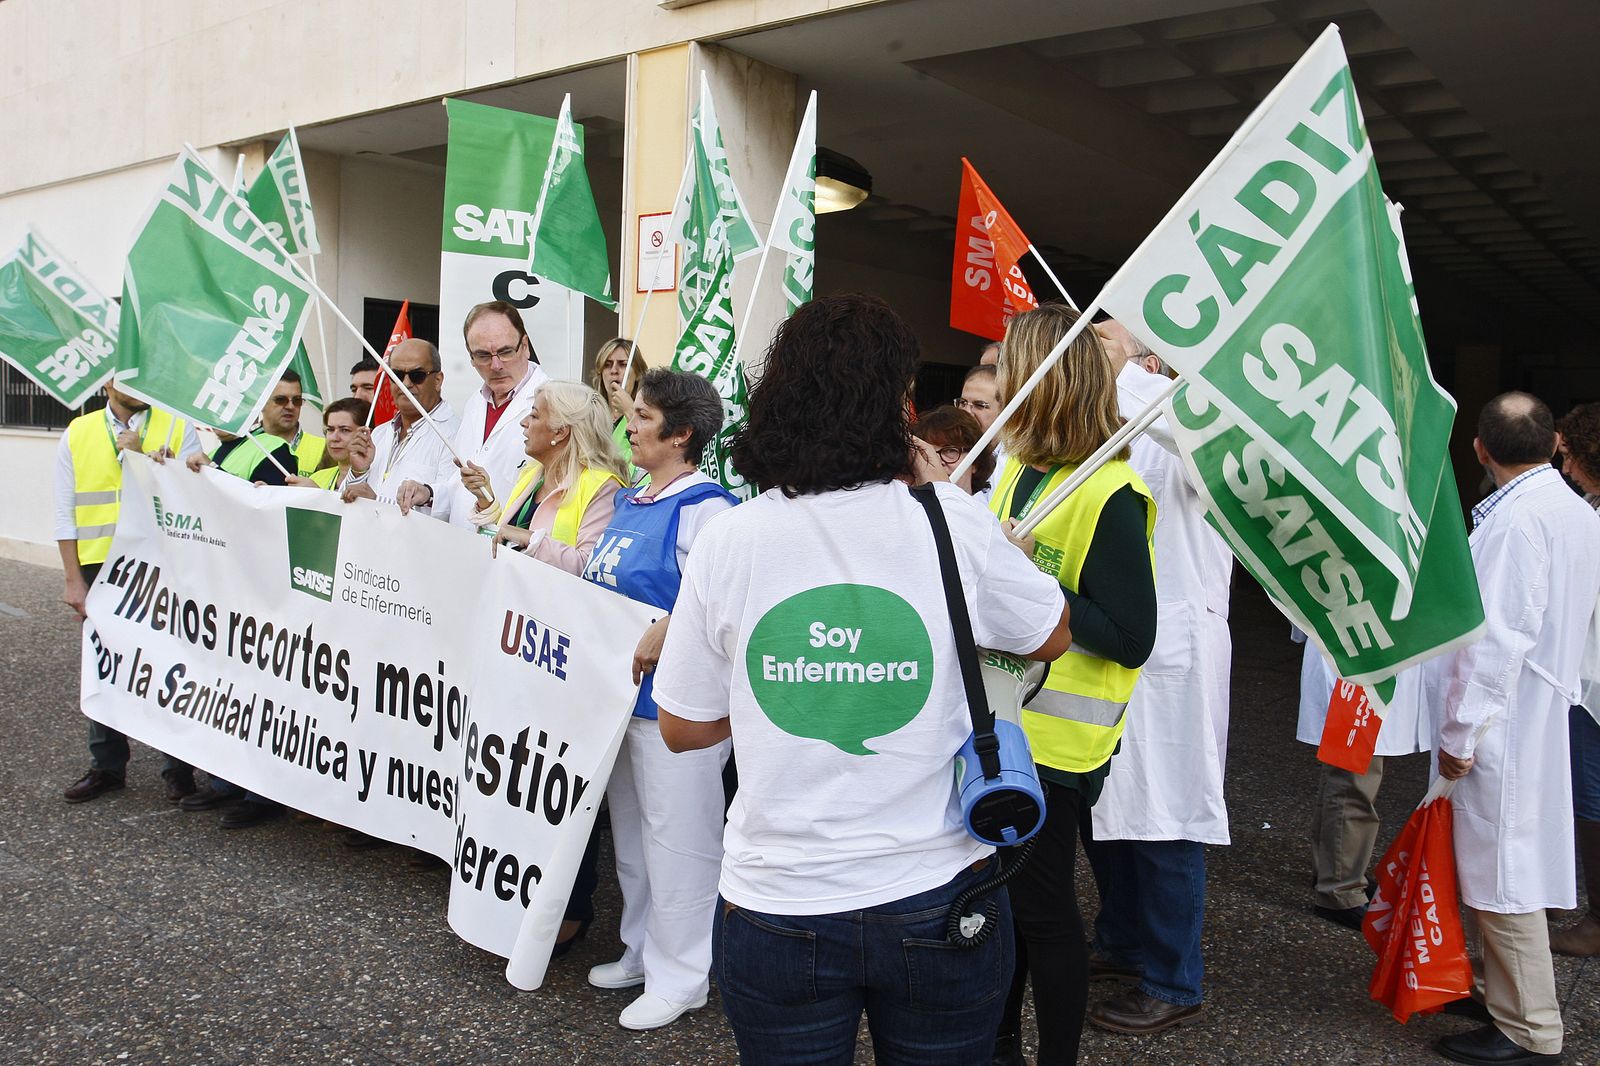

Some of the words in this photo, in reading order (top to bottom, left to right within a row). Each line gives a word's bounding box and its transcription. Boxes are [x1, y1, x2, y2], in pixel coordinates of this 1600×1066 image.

[1143, 64, 1368, 348] CÁDIZ
[1222, 439, 1396, 658] SATSE
[293, 566, 333, 596] SATSE
[343, 562, 400, 593] Sindicato
[342, 586, 358, 604] de
[809, 621, 862, 653] Soy
[227, 611, 360, 719] recortes,
[763, 655, 919, 683] Enfermera
[127, 647, 153, 699] la
[158, 662, 257, 743] Sanidad
[257, 698, 348, 782] Pública
[358, 748, 377, 802] y
